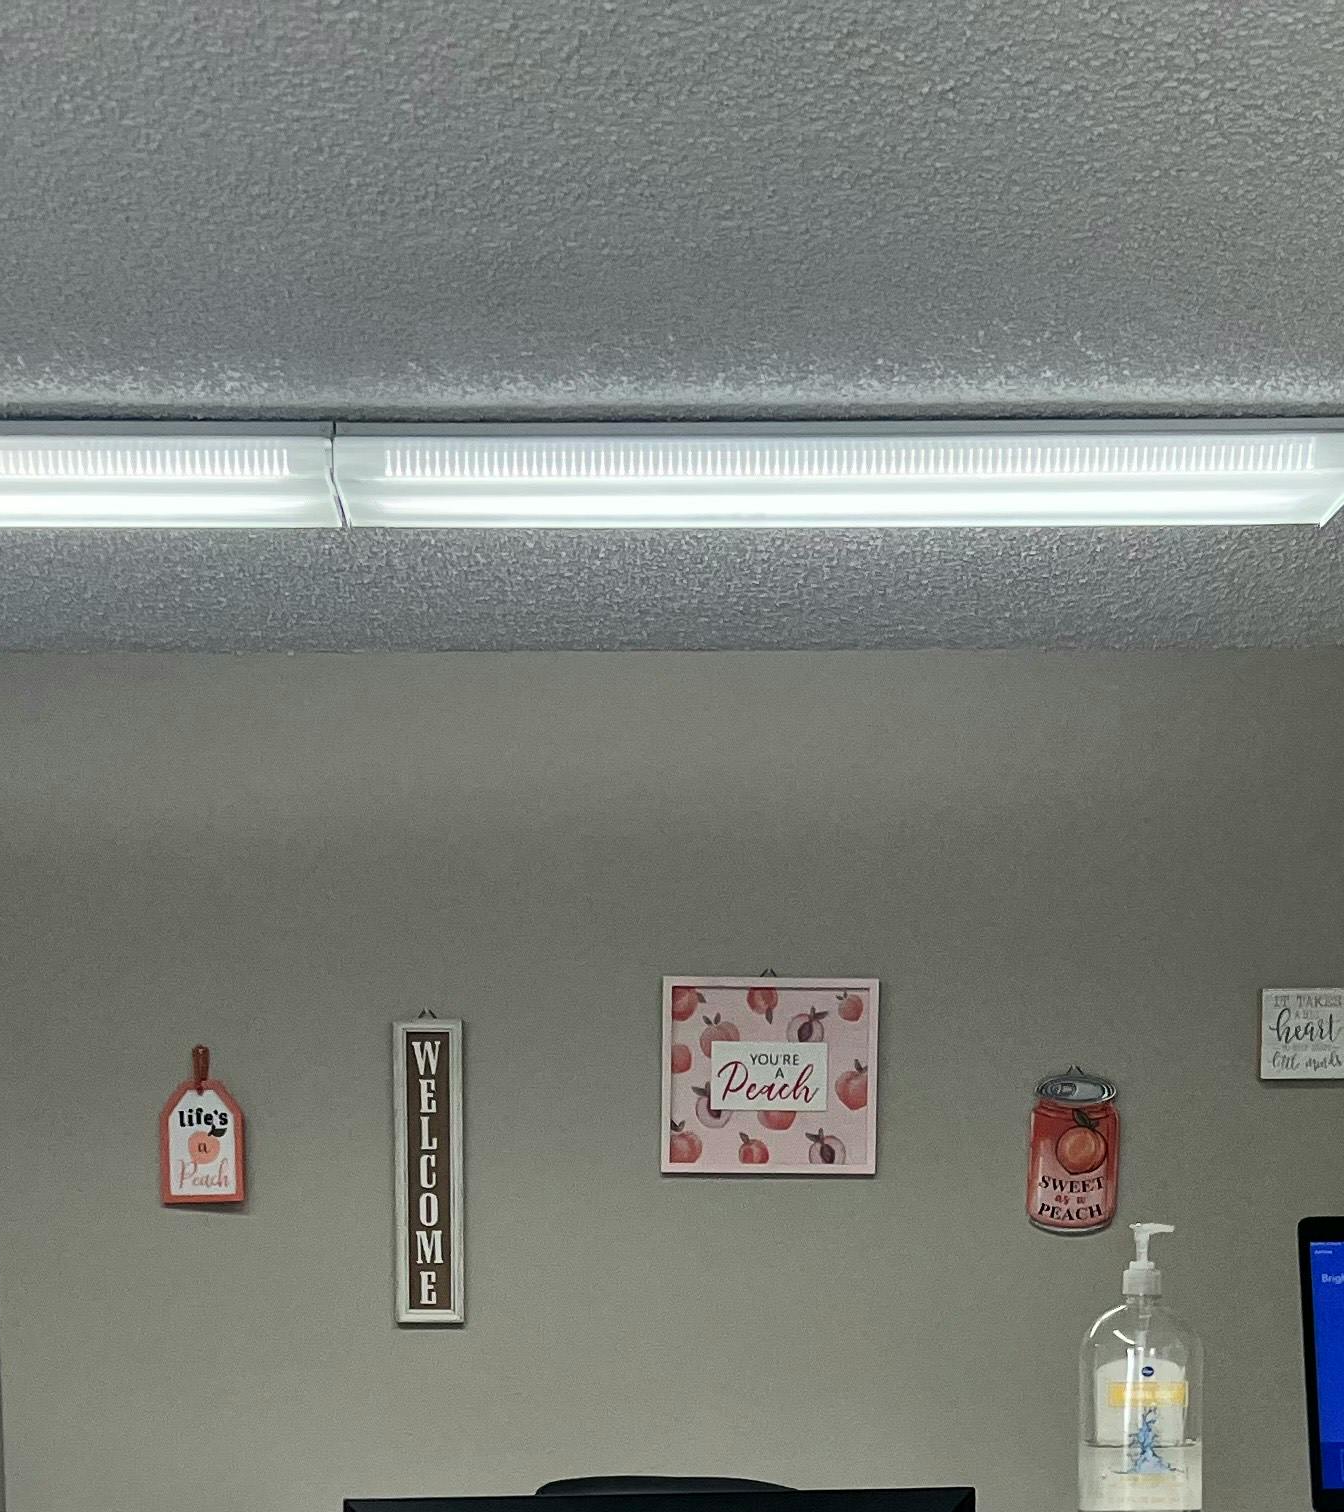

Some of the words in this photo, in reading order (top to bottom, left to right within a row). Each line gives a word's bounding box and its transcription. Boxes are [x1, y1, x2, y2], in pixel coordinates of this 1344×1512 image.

[1268, 1007, 1344, 1044] heart
[749, 1053, 800, 1066] YOU'RE
[717, 1060, 820, 1104] Peach
[775, 1067, 785, 1079] A
[178, 1107, 228, 1128] life's
[197, 1142, 209, 1154] a
[178, 1157, 229, 1189] Peach
[411, 1040, 444, 1306] WELCOME
[1038, 1175, 1105, 1193] SWEET
[1054, 1194, 1069, 1206] as
[1038, 1202, 1104, 1221] PEACH
